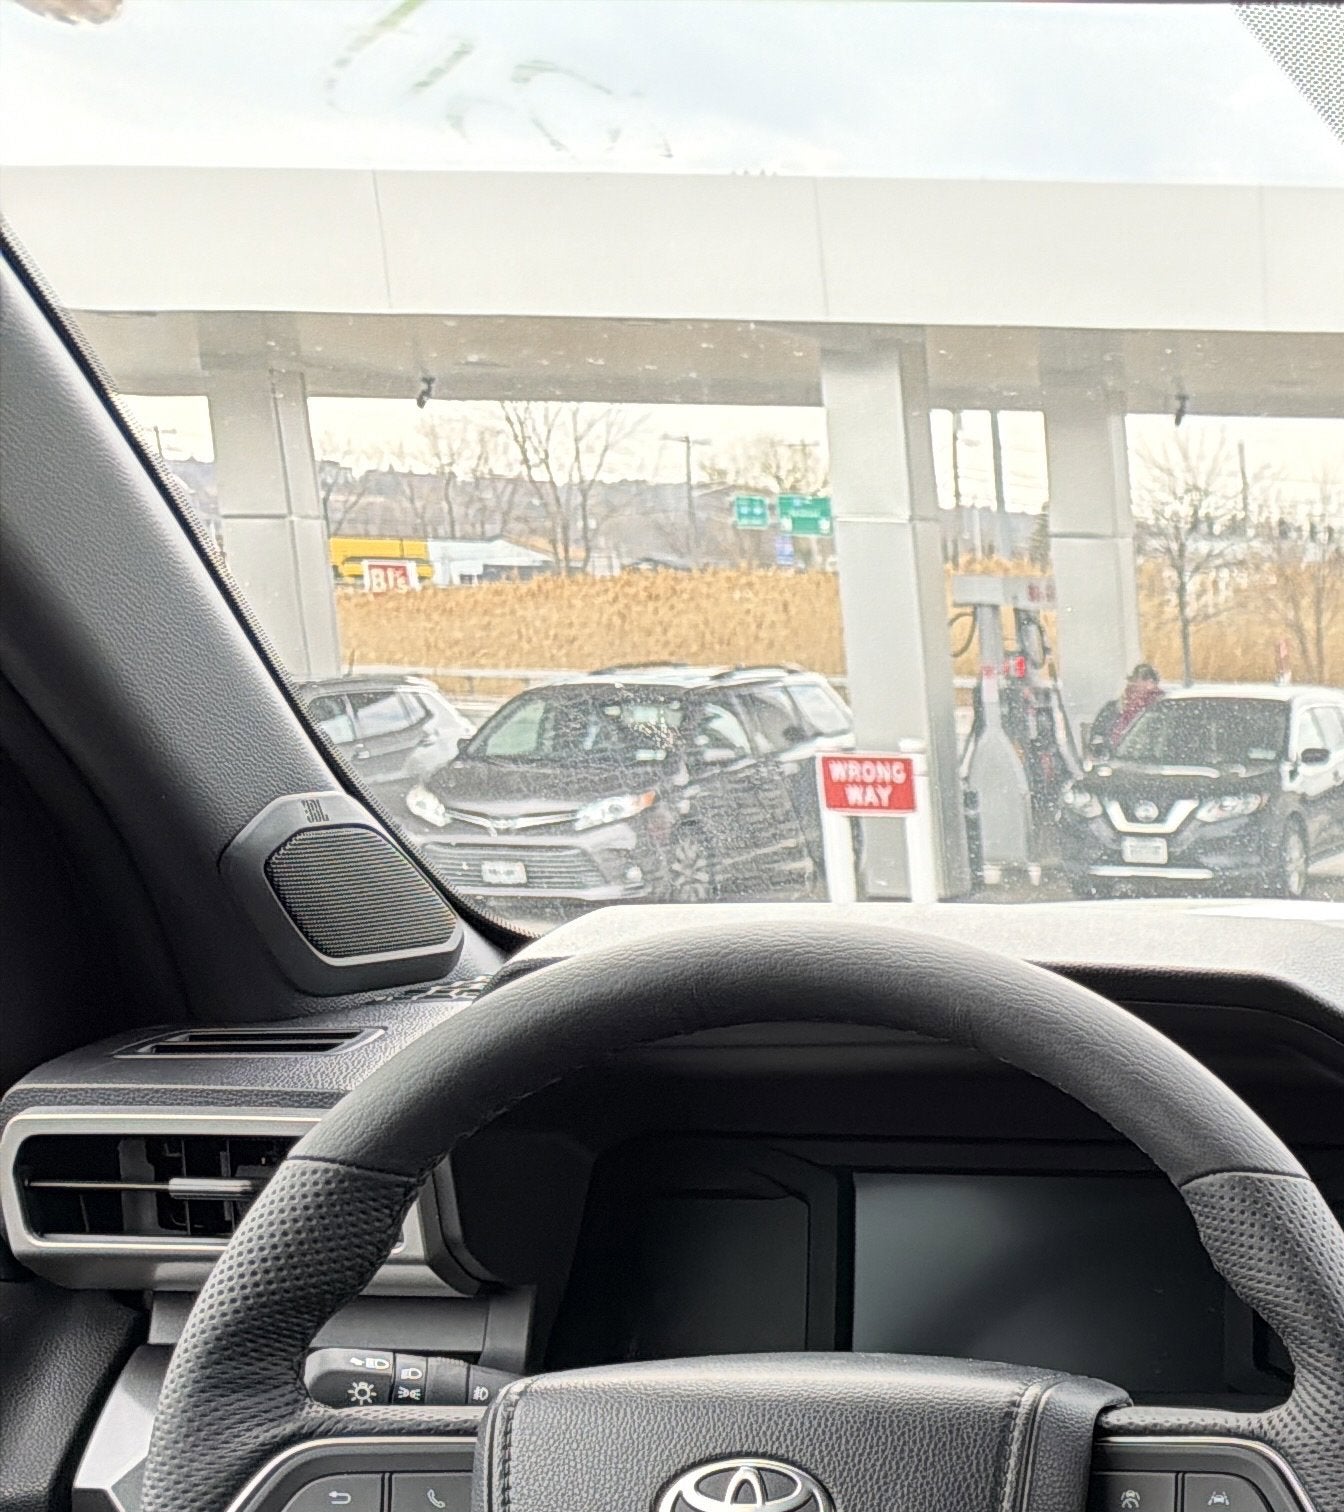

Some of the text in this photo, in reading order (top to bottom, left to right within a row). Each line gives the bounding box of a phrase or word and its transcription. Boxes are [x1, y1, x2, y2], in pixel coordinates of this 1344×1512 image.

[827, 759, 907, 785] WRONG
[843, 783, 894, 807] WAY
[300, 799, 330, 823] JBL
